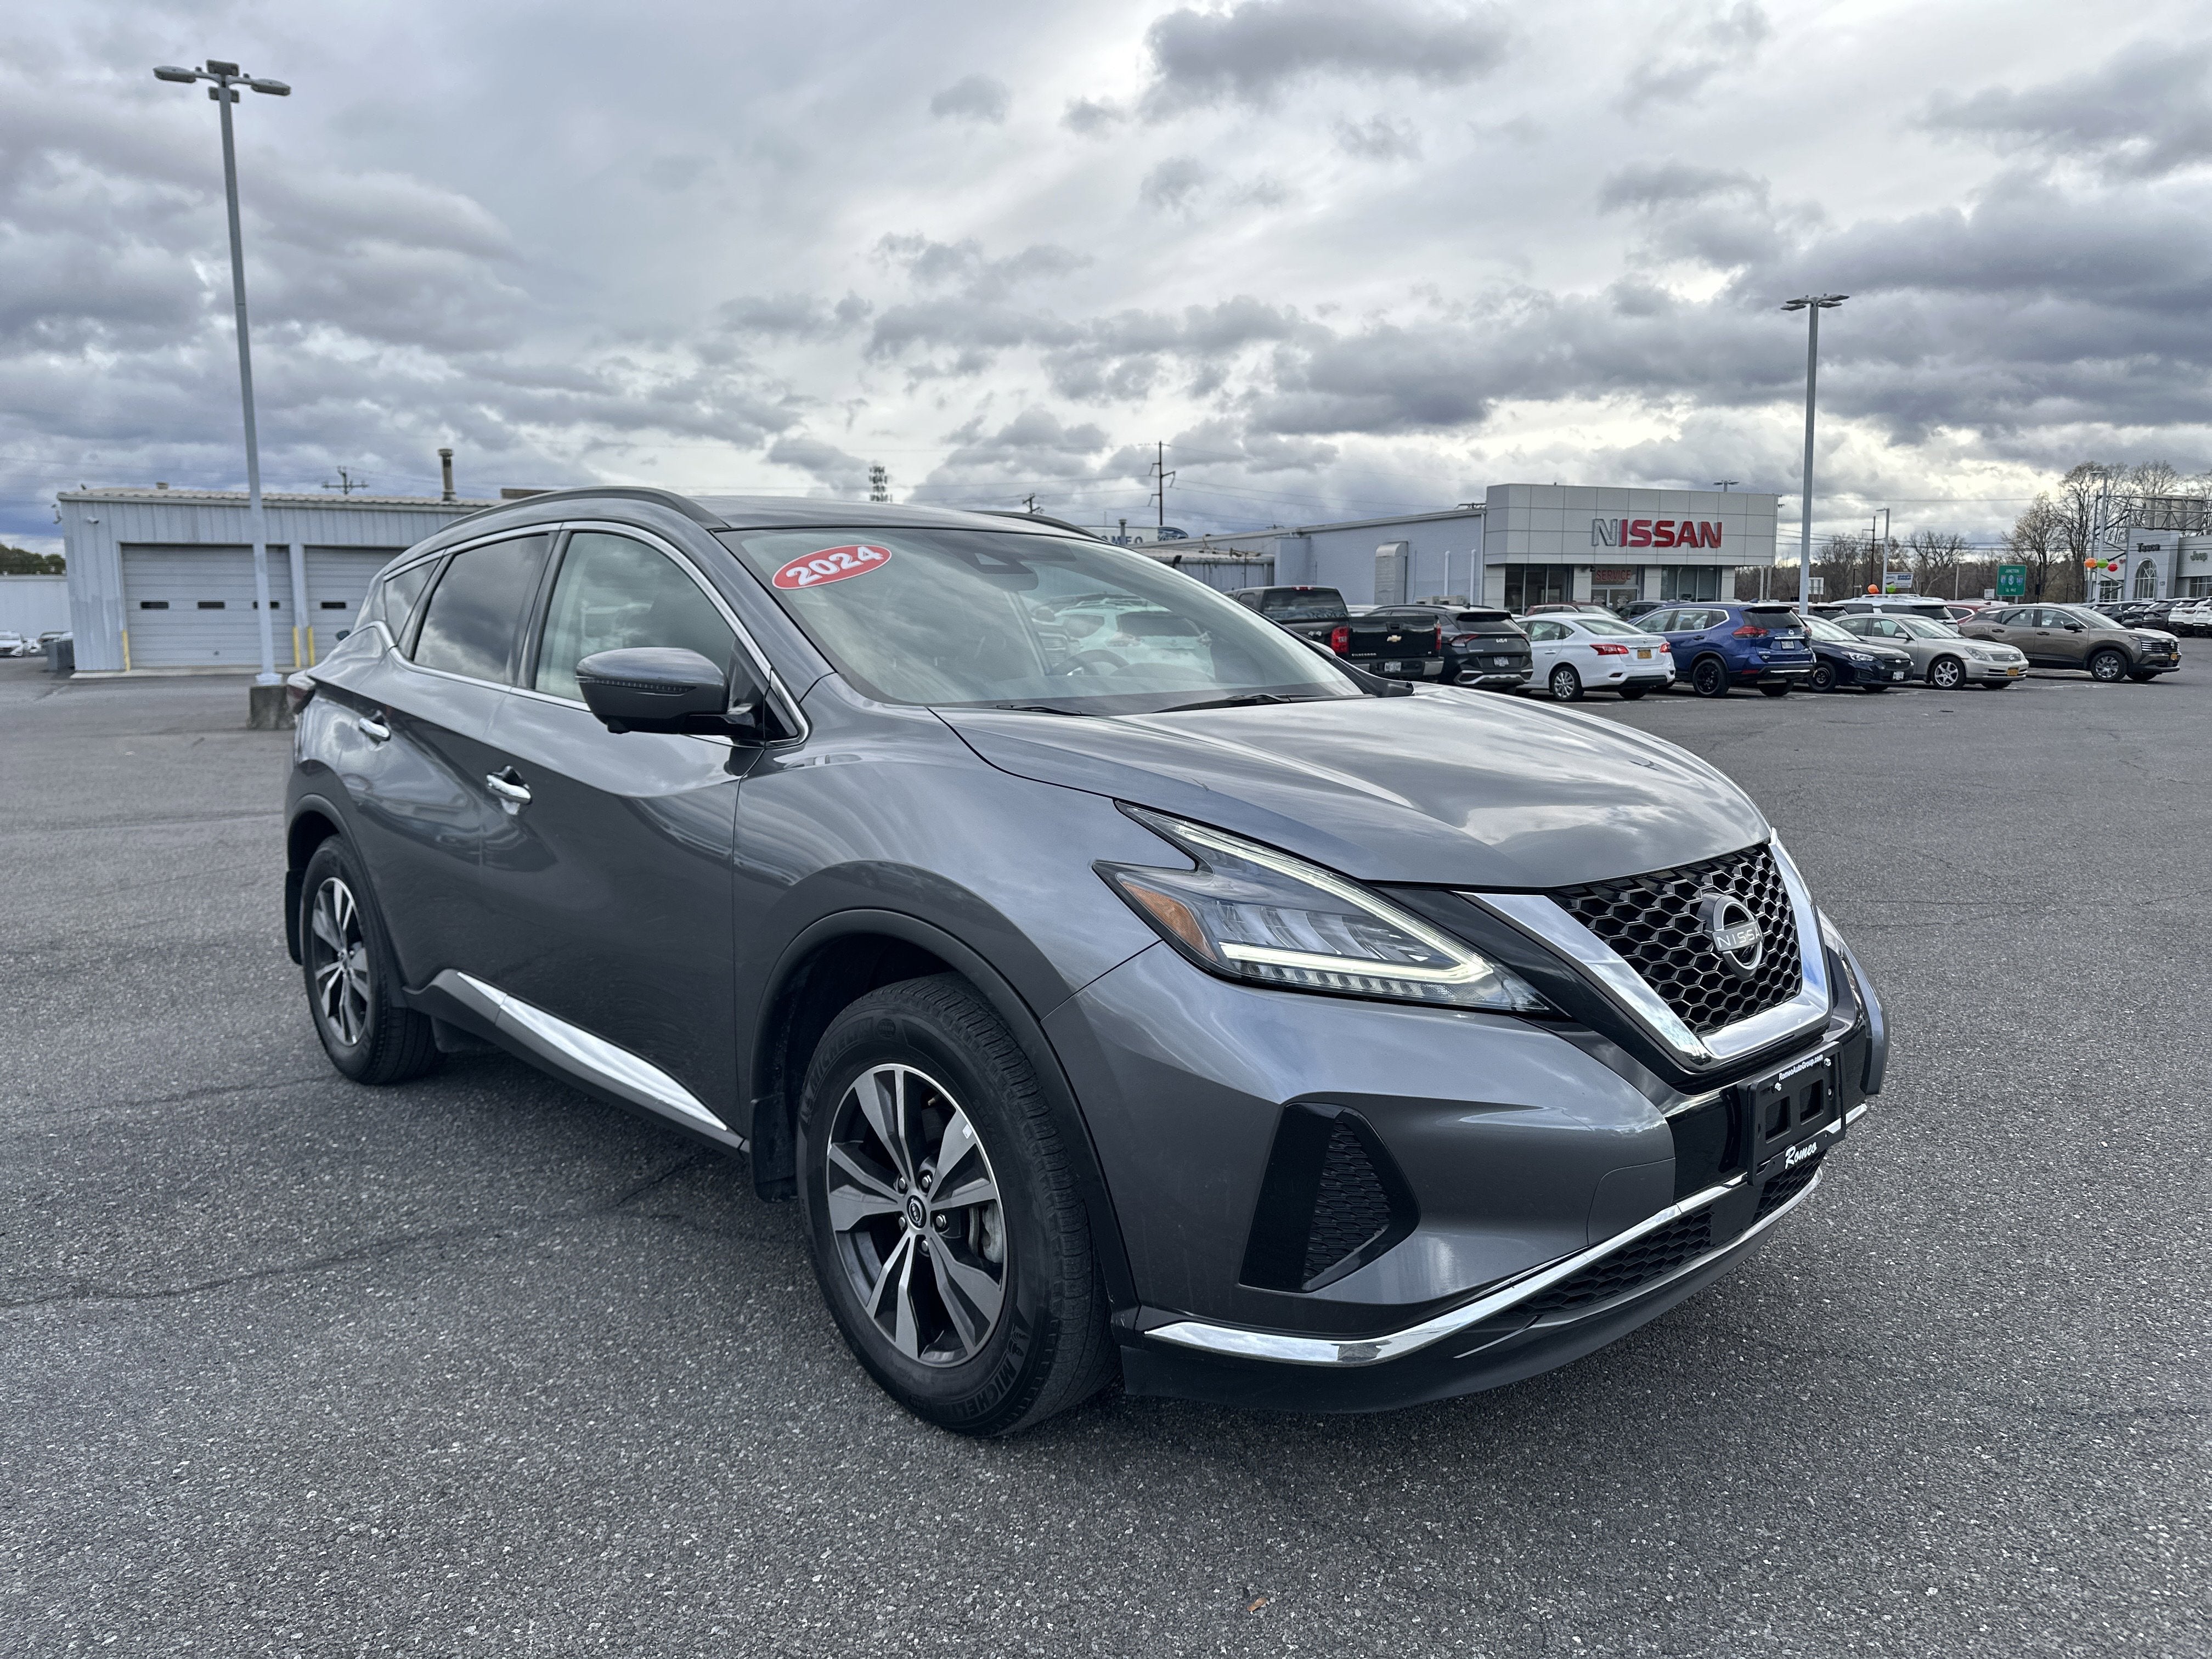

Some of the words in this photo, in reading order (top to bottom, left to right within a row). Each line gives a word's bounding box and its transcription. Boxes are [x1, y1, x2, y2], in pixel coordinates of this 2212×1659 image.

[1592, 518, 1722, 548] NISSAN
[786, 546, 884, 585] 2024
[1596, 569, 1631, 580] SERVICE
[1716, 927, 1761, 948] NISSA
[1779, 1054, 1823, 1081] RomeoAutoGroup.com
[1785, 1142, 1818, 1169] Romeo
